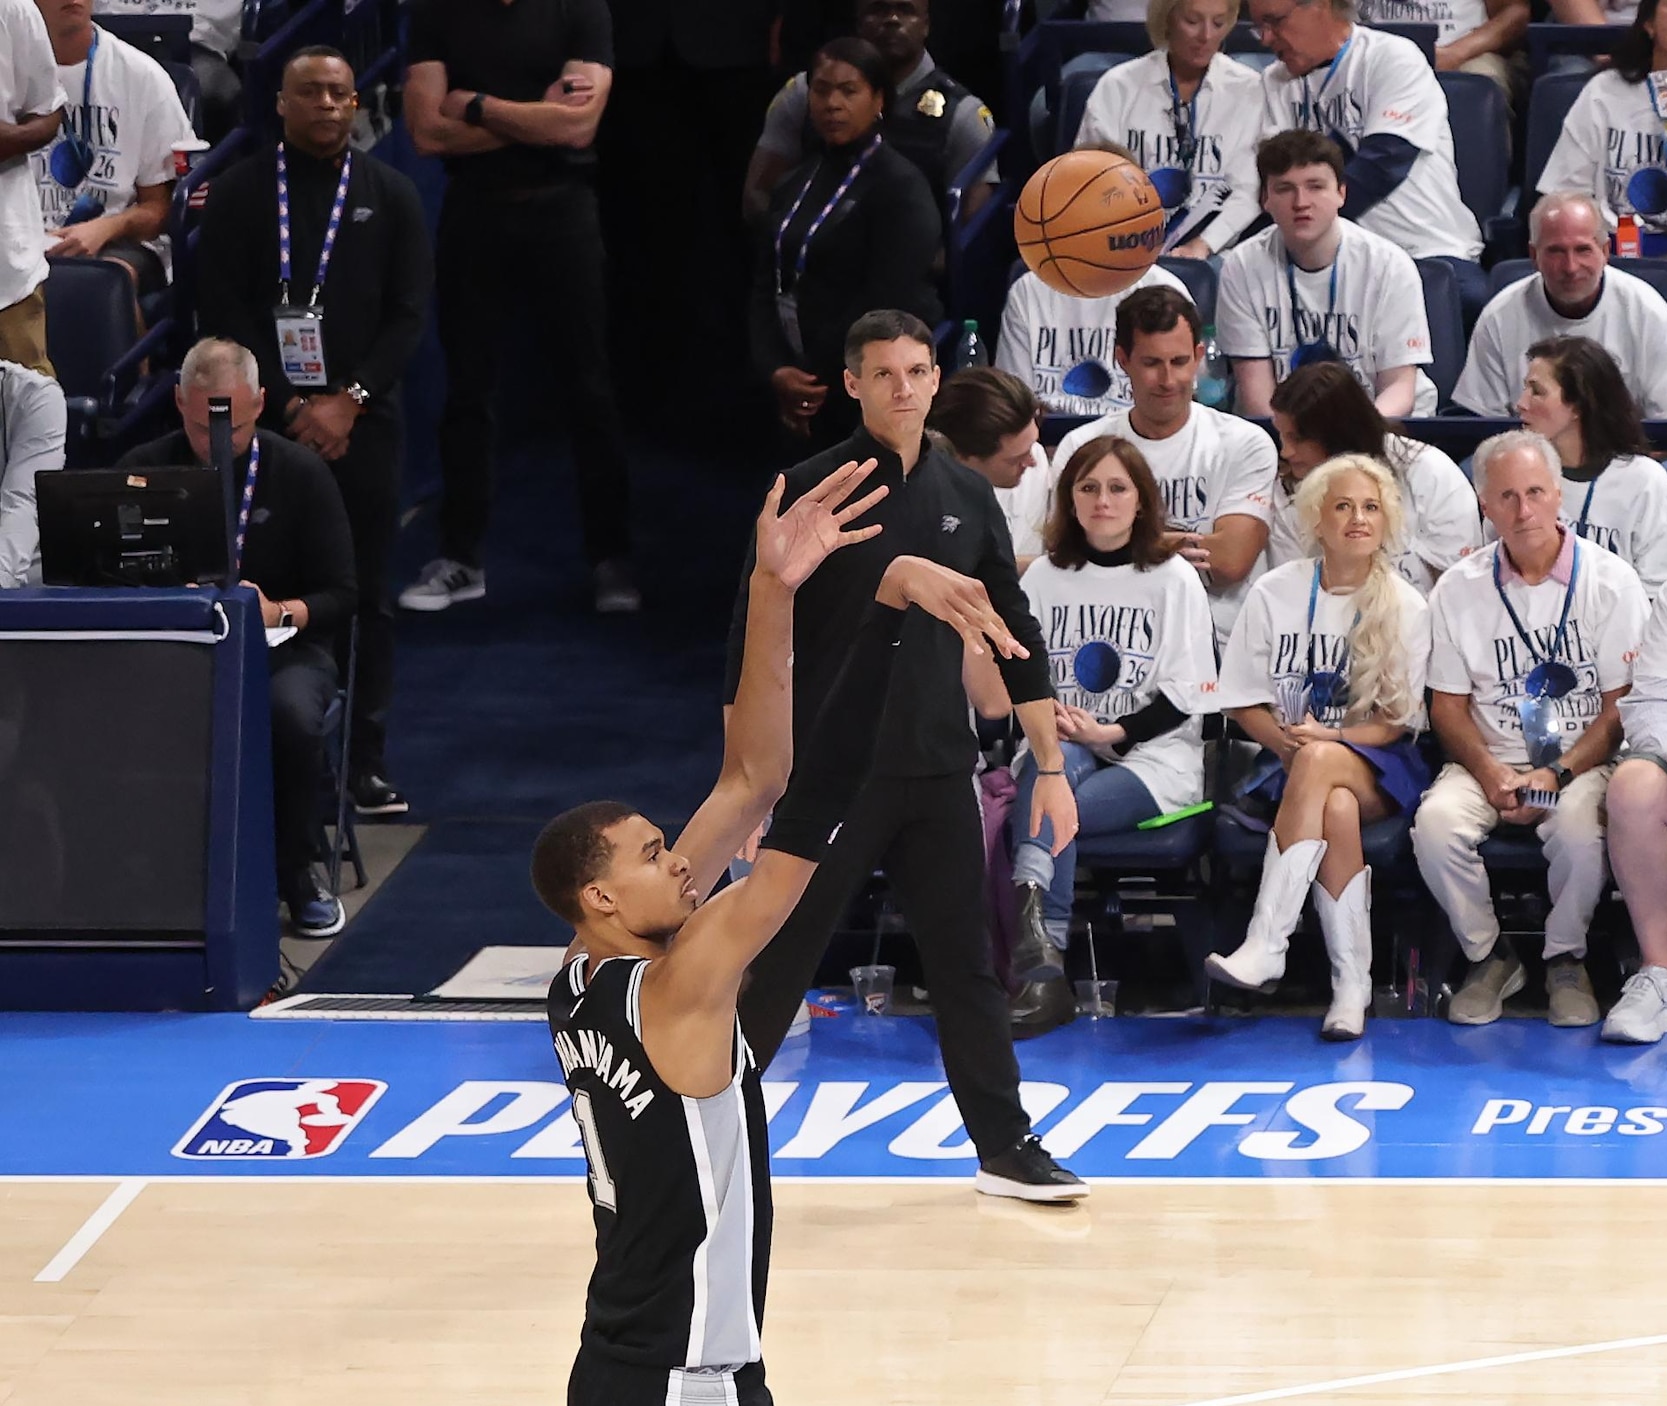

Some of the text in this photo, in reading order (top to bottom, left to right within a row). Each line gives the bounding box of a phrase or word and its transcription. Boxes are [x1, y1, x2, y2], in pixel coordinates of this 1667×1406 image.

[1036, 325, 1117, 369] PLAYO
[1049, 603, 1156, 655] PLAYOFFS
[1125, 659, 1147, 686] 26
[368, 1080, 1416, 1161] PLYOFFS
[197, 1139, 275, 1155] NBA
[572, 1087, 617, 1214] 1
